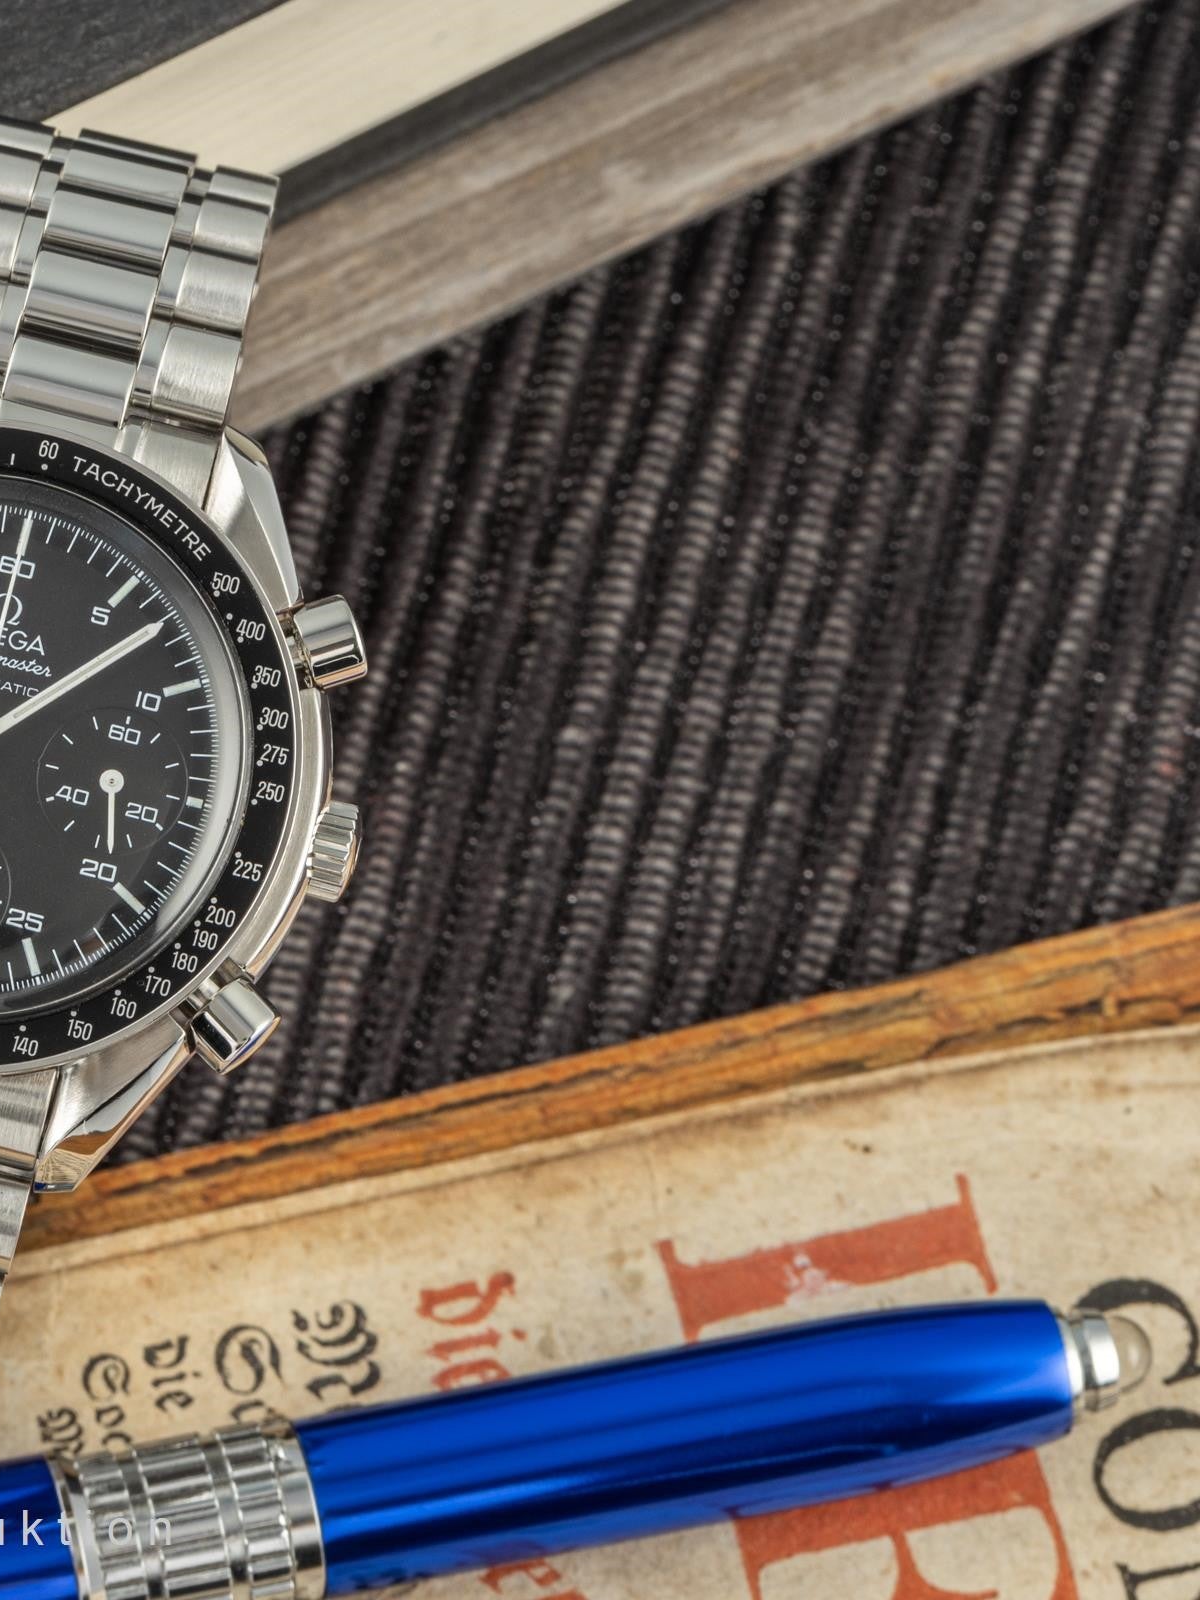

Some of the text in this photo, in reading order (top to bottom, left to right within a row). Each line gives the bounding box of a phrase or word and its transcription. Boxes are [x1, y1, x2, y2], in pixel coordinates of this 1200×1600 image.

[38, 439, 59, 459] 60
[73, 456, 212, 562] TACHYMETRE
[211, 572, 241, 595] 500
[90, 606, 111, 627] 5
[236, 619, 266, 641] 400
[254, 665, 282, 687] 350
[135, 691, 162, 712] 10
[259, 707, 289, 730] 300
[108, 725, 141, 746] 60
[260, 744, 290, 766] 275
[55, 785, 90, 806] 40
[255, 781, 285, 803] 250
[125, 802, 159, 823] 20
[79, 858, 118, 883] 20
[232, 858, 263, 882] 225
[5, 908, 45, 933] 25
[205, 905, 236, 929] 200
[192, 928, 218, 951] 190
[171, 951, 198, 973] 180
[144, 975, 171, 997] 170
[111, 996, 137, 1019] 160
[67, 1018, 93, 1041] 150
[12, 1034, 39, 1057] 140
